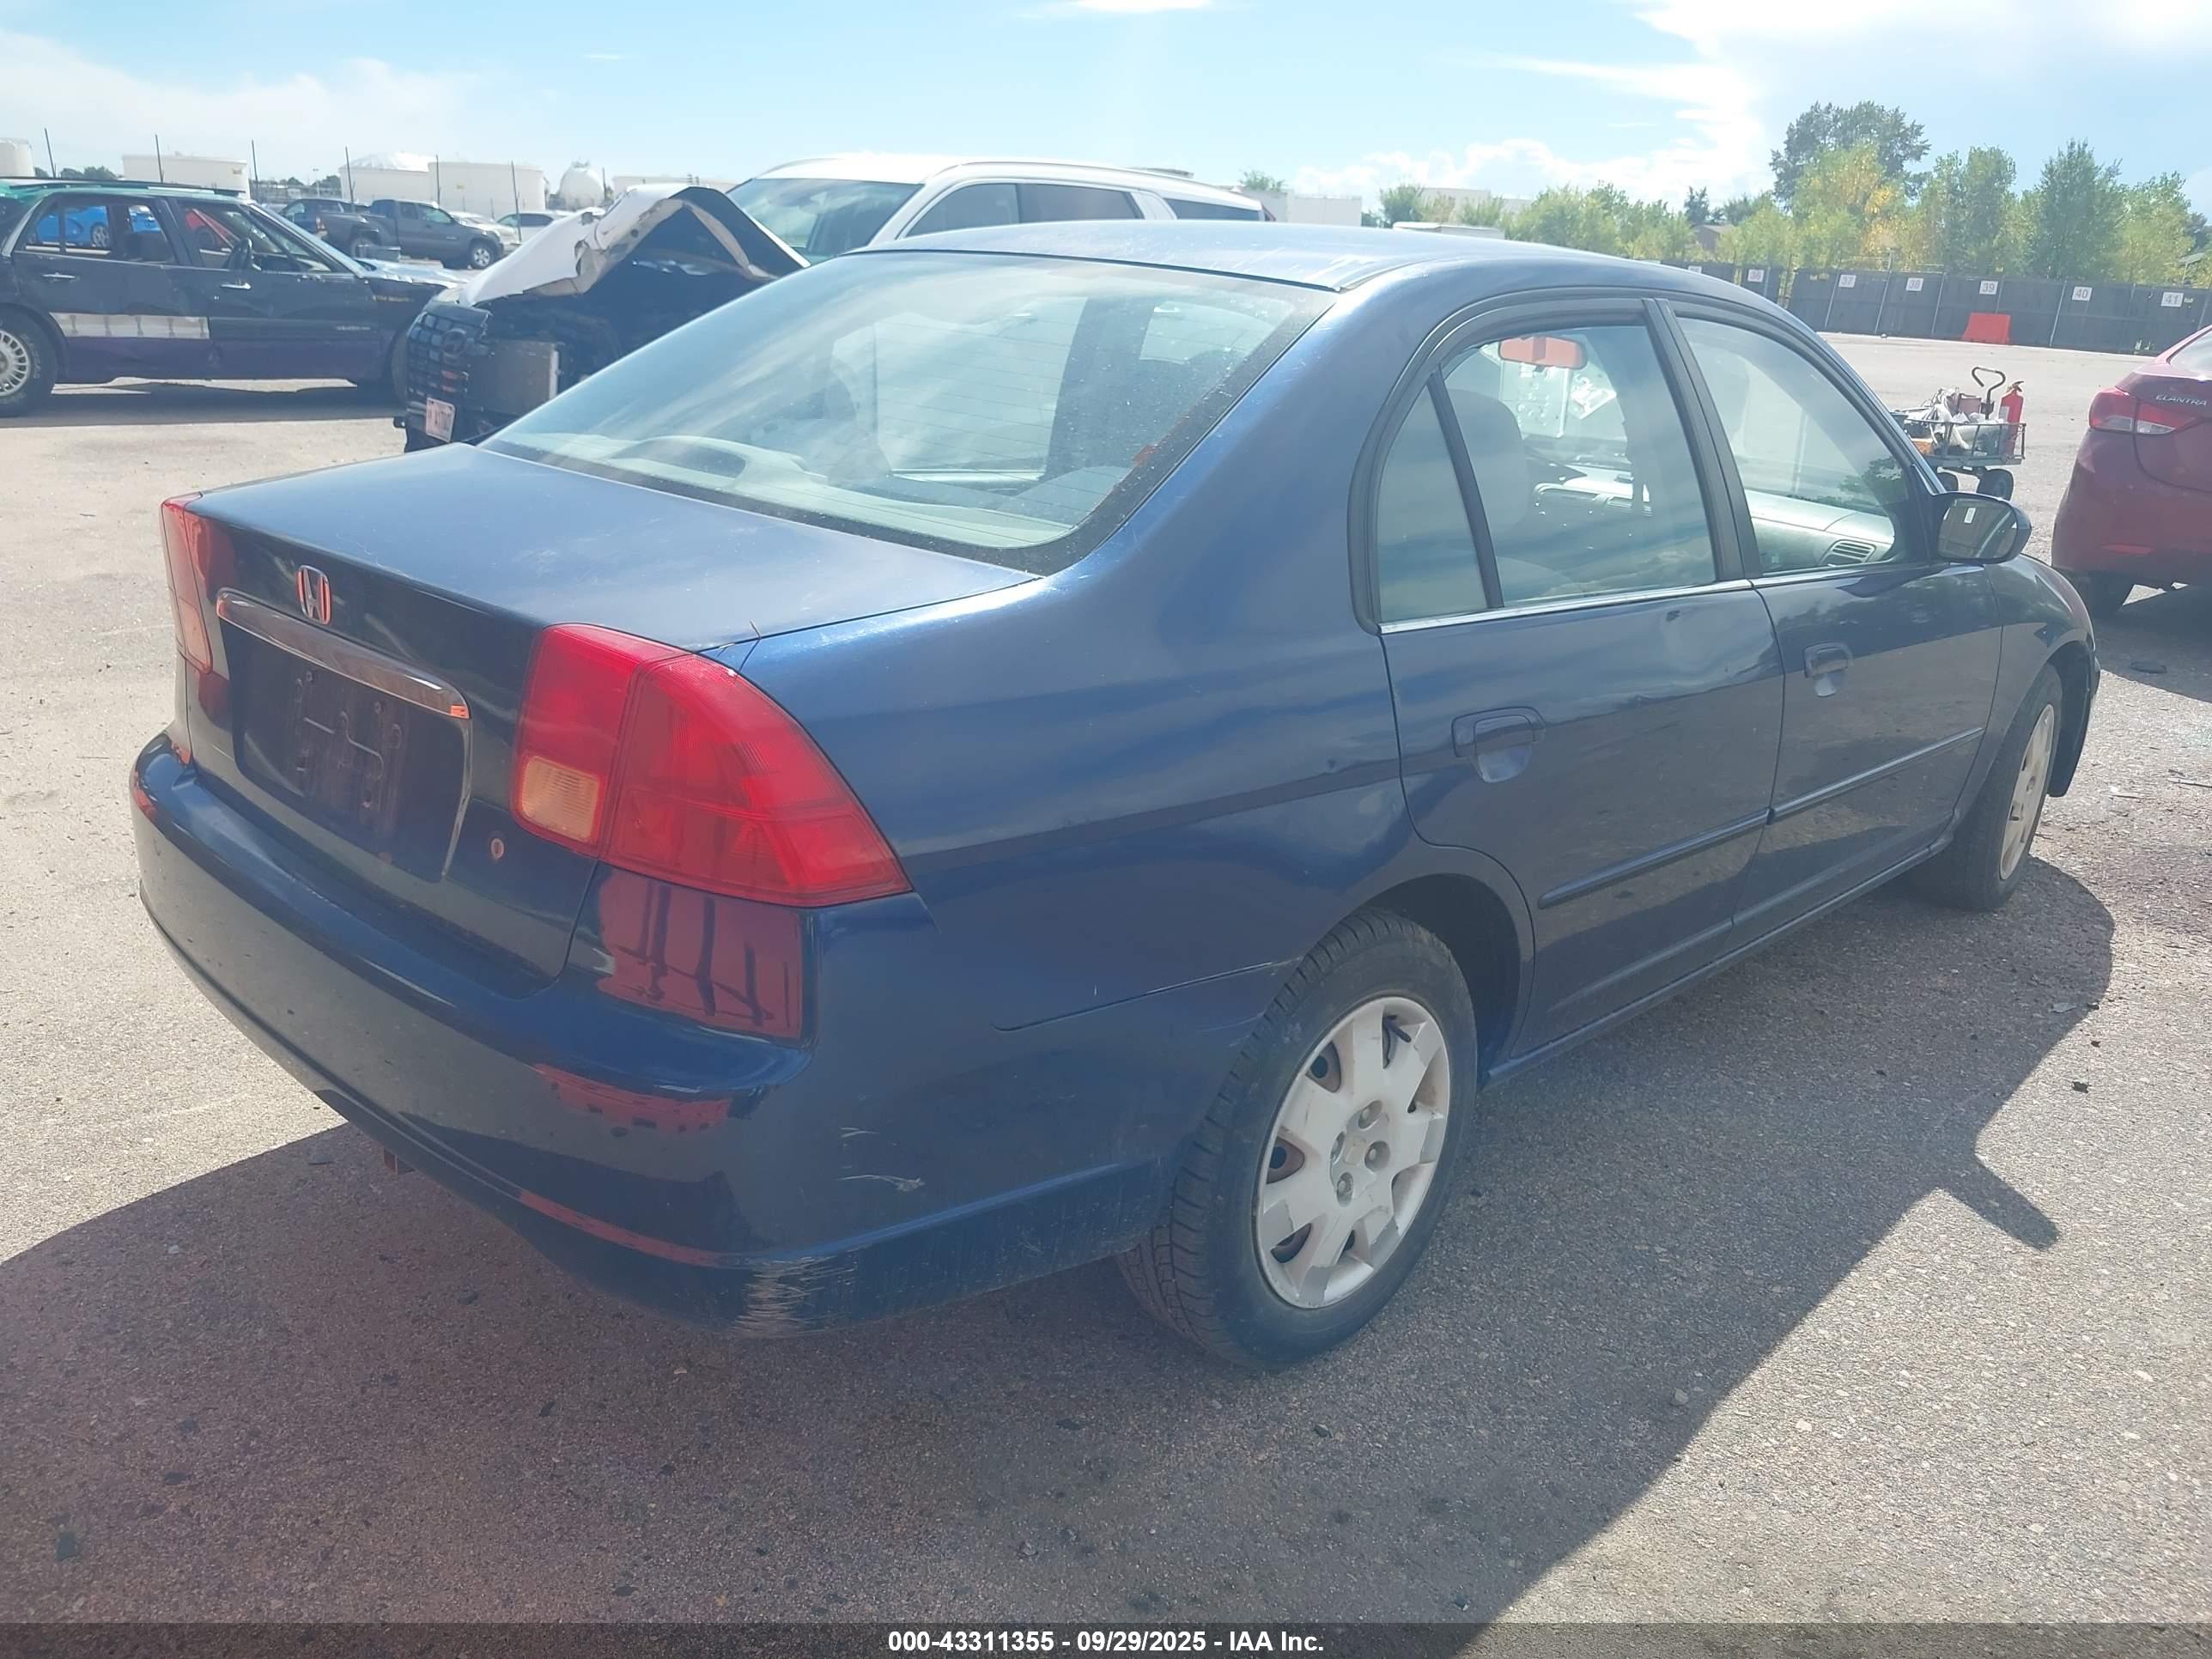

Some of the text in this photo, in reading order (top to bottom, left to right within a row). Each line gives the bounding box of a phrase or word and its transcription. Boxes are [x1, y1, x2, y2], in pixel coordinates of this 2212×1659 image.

[1982, 282, 1995, 293] 39
[2075, 289, 2088, 300] 40
[2165, 294, 2181, 306] 41
[2155, 394, 2207, 406] ELANTRA
